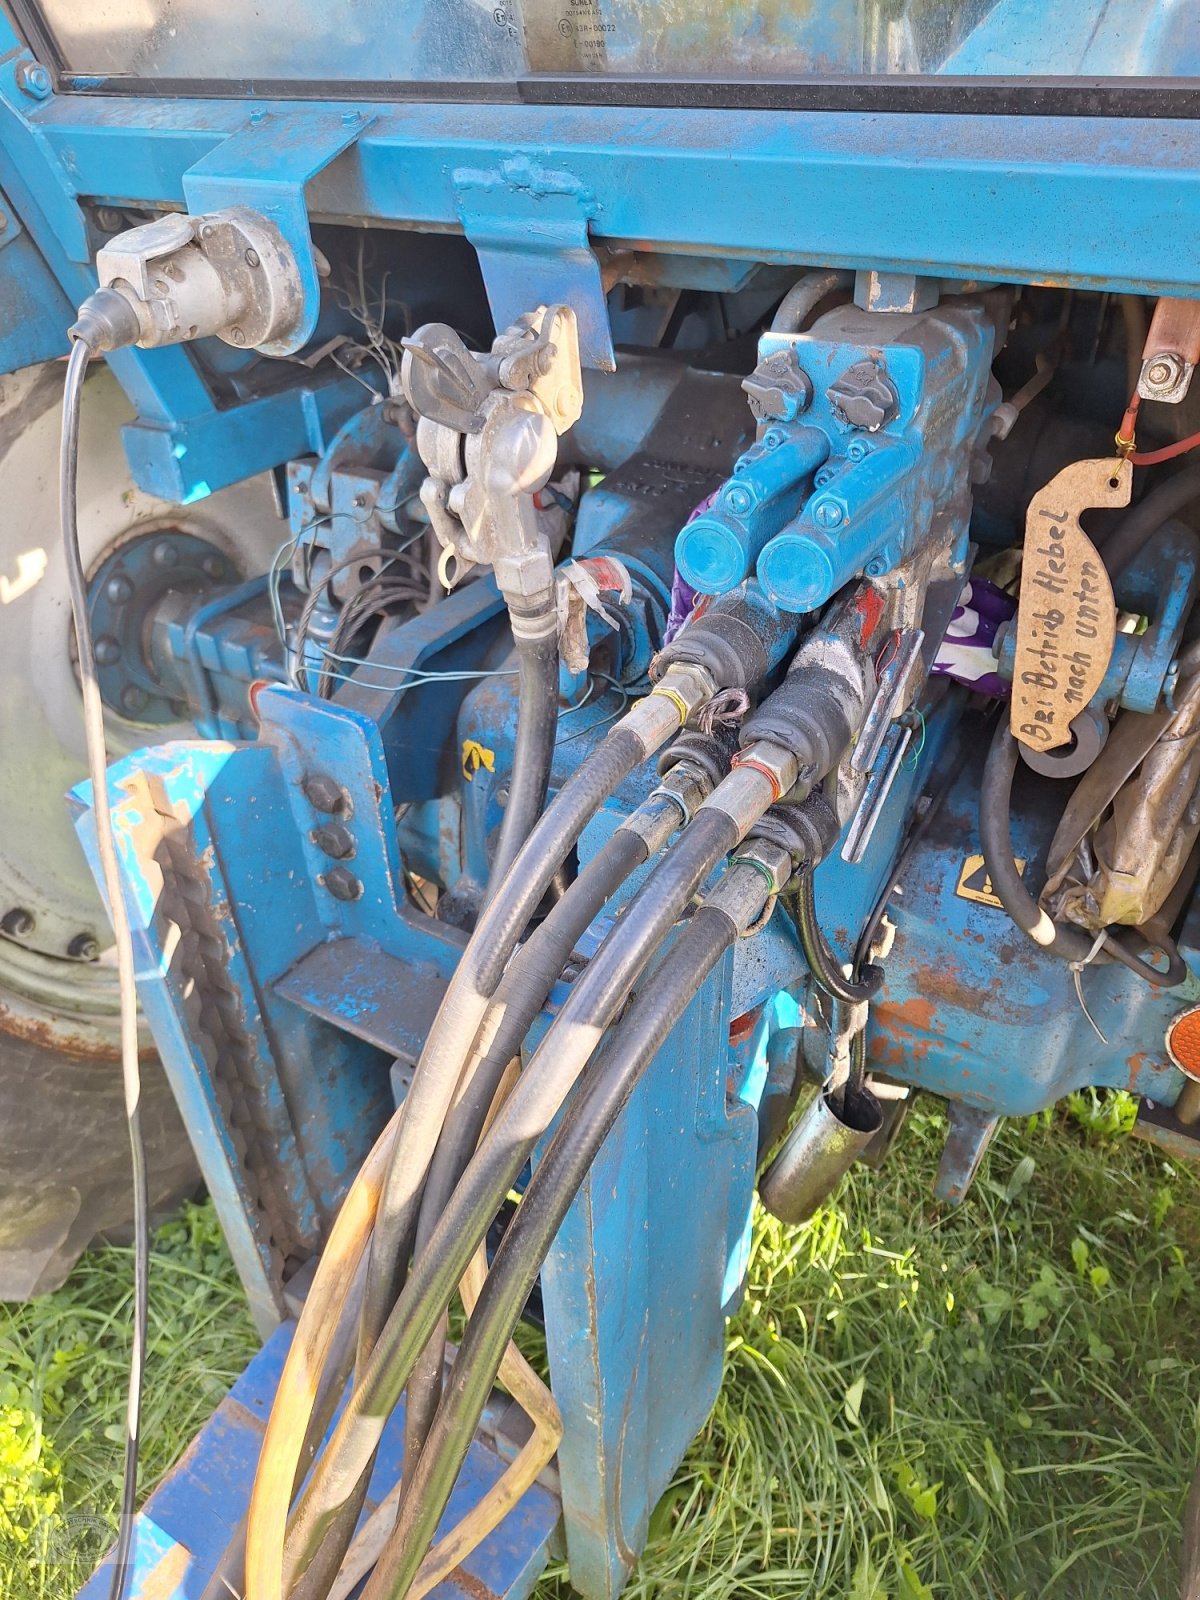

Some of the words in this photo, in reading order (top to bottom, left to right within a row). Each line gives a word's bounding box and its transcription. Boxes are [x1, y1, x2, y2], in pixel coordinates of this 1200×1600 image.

[1032, 509, 1069, 594] Hebel
[1072, 561, 1100, 639] unten
[1021, 608, 1066, 690] Betrieb
[1062, 651, 1092, 704] nach
[1019, 695, 1055, 742] Bei
